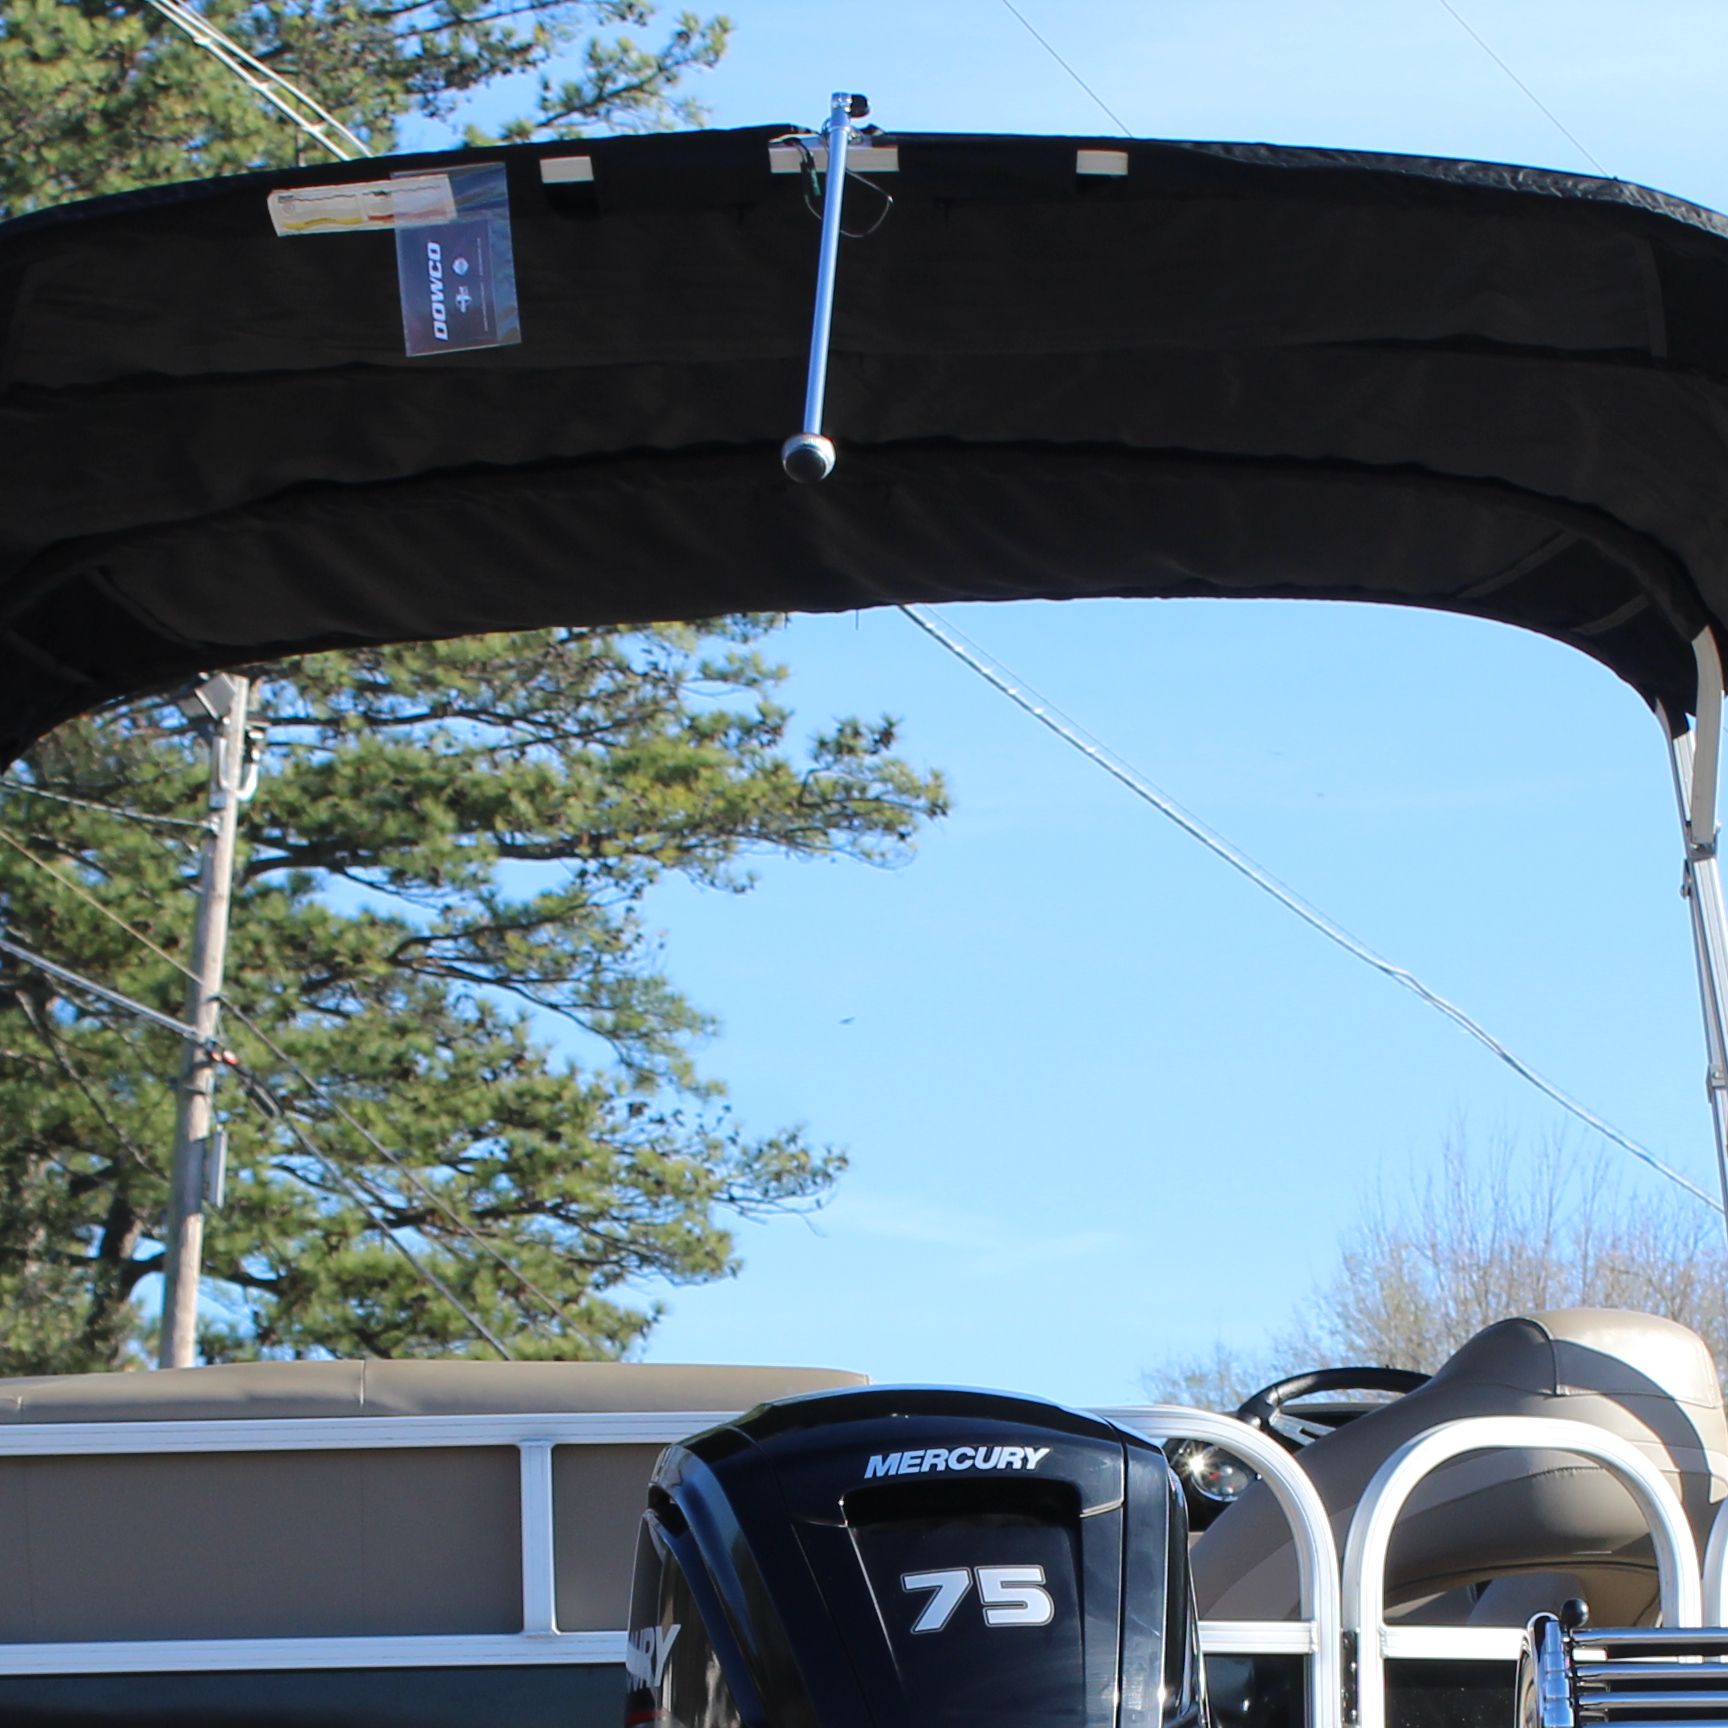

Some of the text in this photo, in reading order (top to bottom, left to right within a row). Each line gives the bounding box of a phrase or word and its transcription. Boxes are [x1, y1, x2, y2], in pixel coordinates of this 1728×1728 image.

[427, 241, 448, 341] DOWCO
[864, 1446, 1051, 1478] MERCURY
[900, 1565, 1055, 1634] 75
